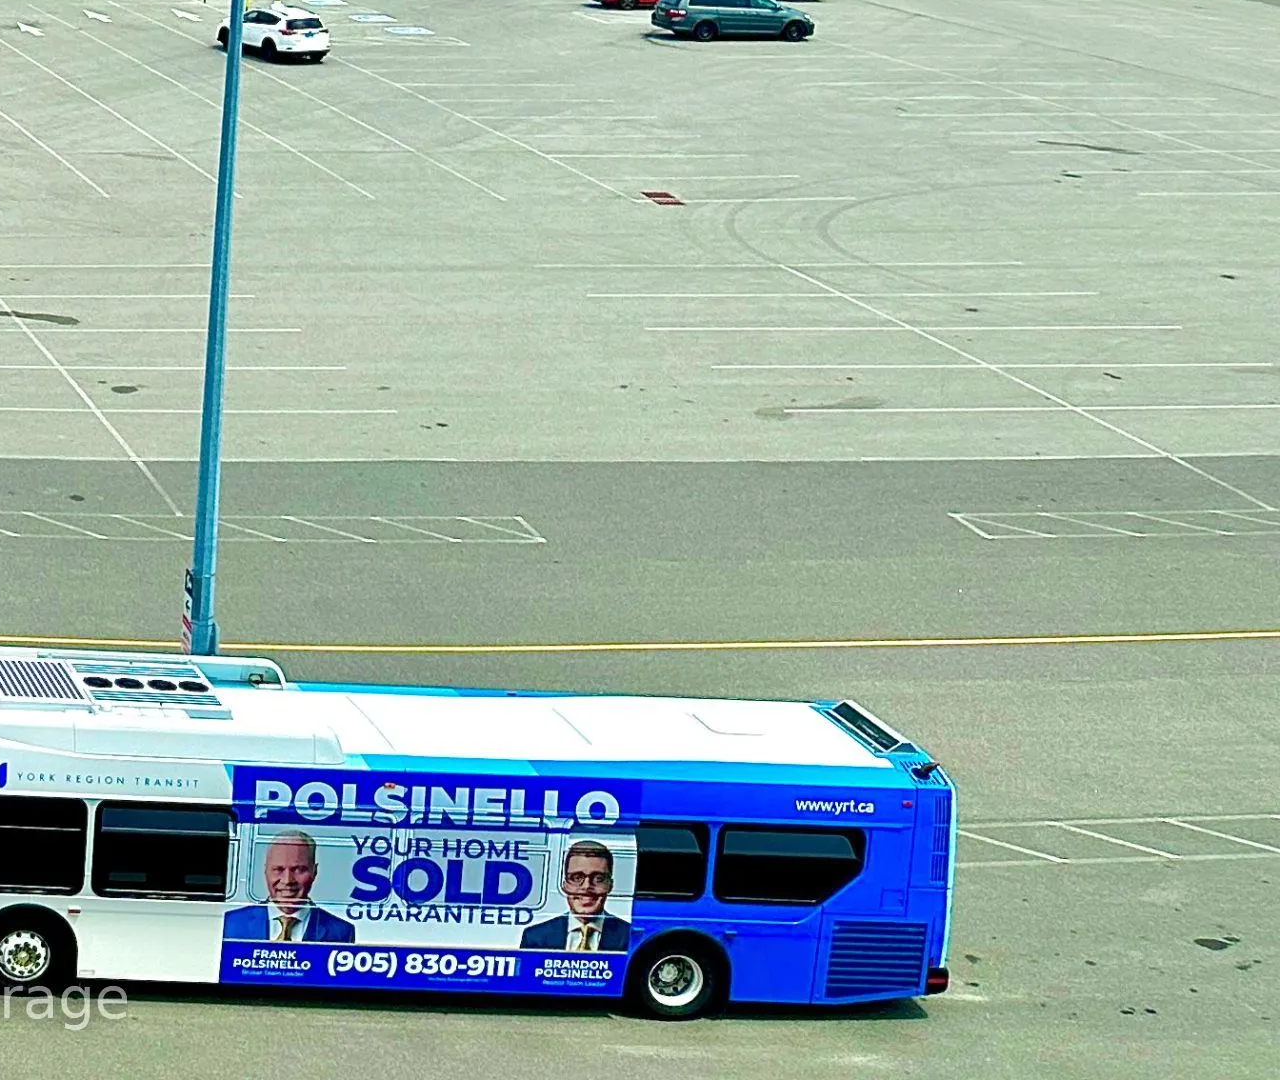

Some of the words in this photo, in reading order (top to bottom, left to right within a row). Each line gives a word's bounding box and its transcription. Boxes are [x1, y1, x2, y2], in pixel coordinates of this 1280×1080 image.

[16, 771, 56, 782] YORK
[65, 773, 125, 785] REGION
[134, 777, 200, 788] TRANSIT
[254, 779, 622, 829] POLSINELLO
[795, 799, 875, 816] www.yrt.ca
[351, 834, 433, 858] YOUR
[441, 838, 530, 861] HOME
[349, 855, 534, 906] SOLD
[345, 902, 535, 927] GUARANTEED
[252, 949, 297, 960] FRANK
[232, 958, 311, 971] POLSINELLO
[327, 949, 398, 978] (905)
[404, 953, 516, 977] 830-9111
[544, 959, 609, 970] BRANDON
[534, 968, 613, 980] POLSINELLO
